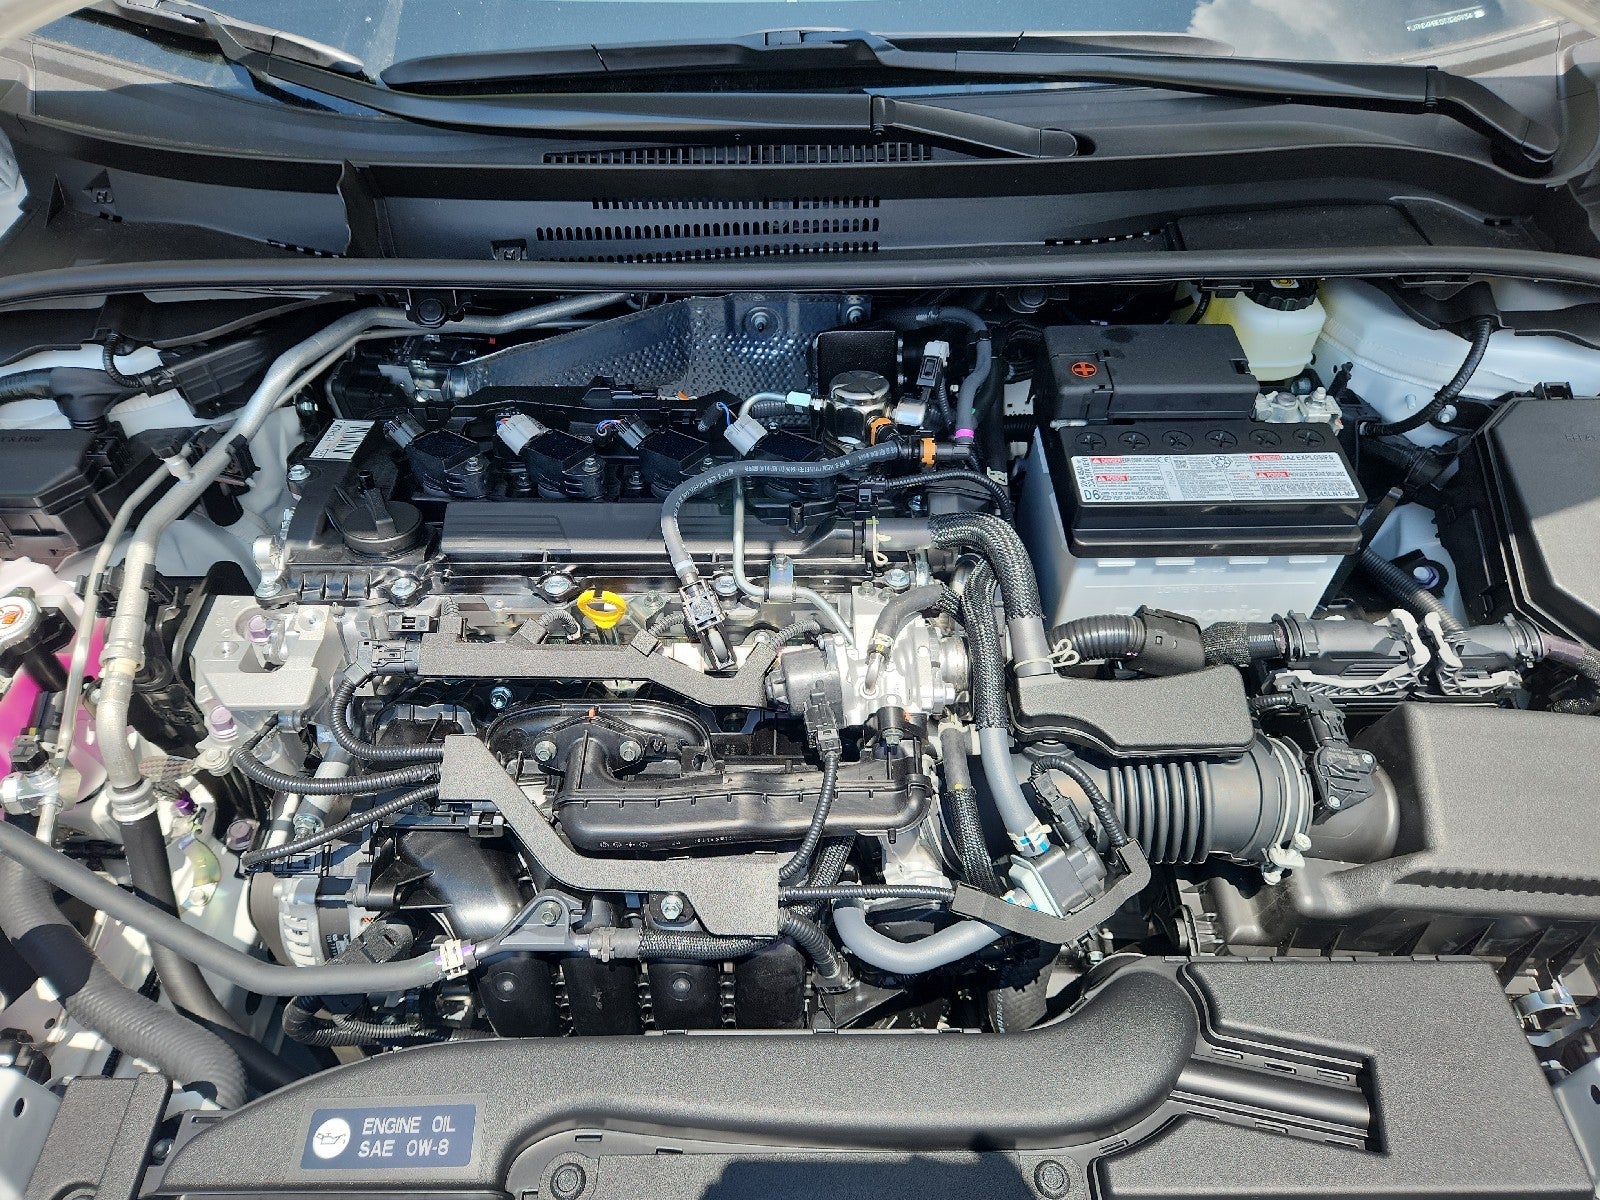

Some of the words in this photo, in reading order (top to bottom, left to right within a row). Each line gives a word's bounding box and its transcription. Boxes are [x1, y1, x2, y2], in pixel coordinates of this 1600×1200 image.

[1083, 489, 1101, 500] D6
[362, 1116, 422, 1135] ENGINE
[432, 1115, 456, 1133] OIL
[358, 1139, 396, 1158] SAE
[406, 1138, 450, 1157] 0W-8
